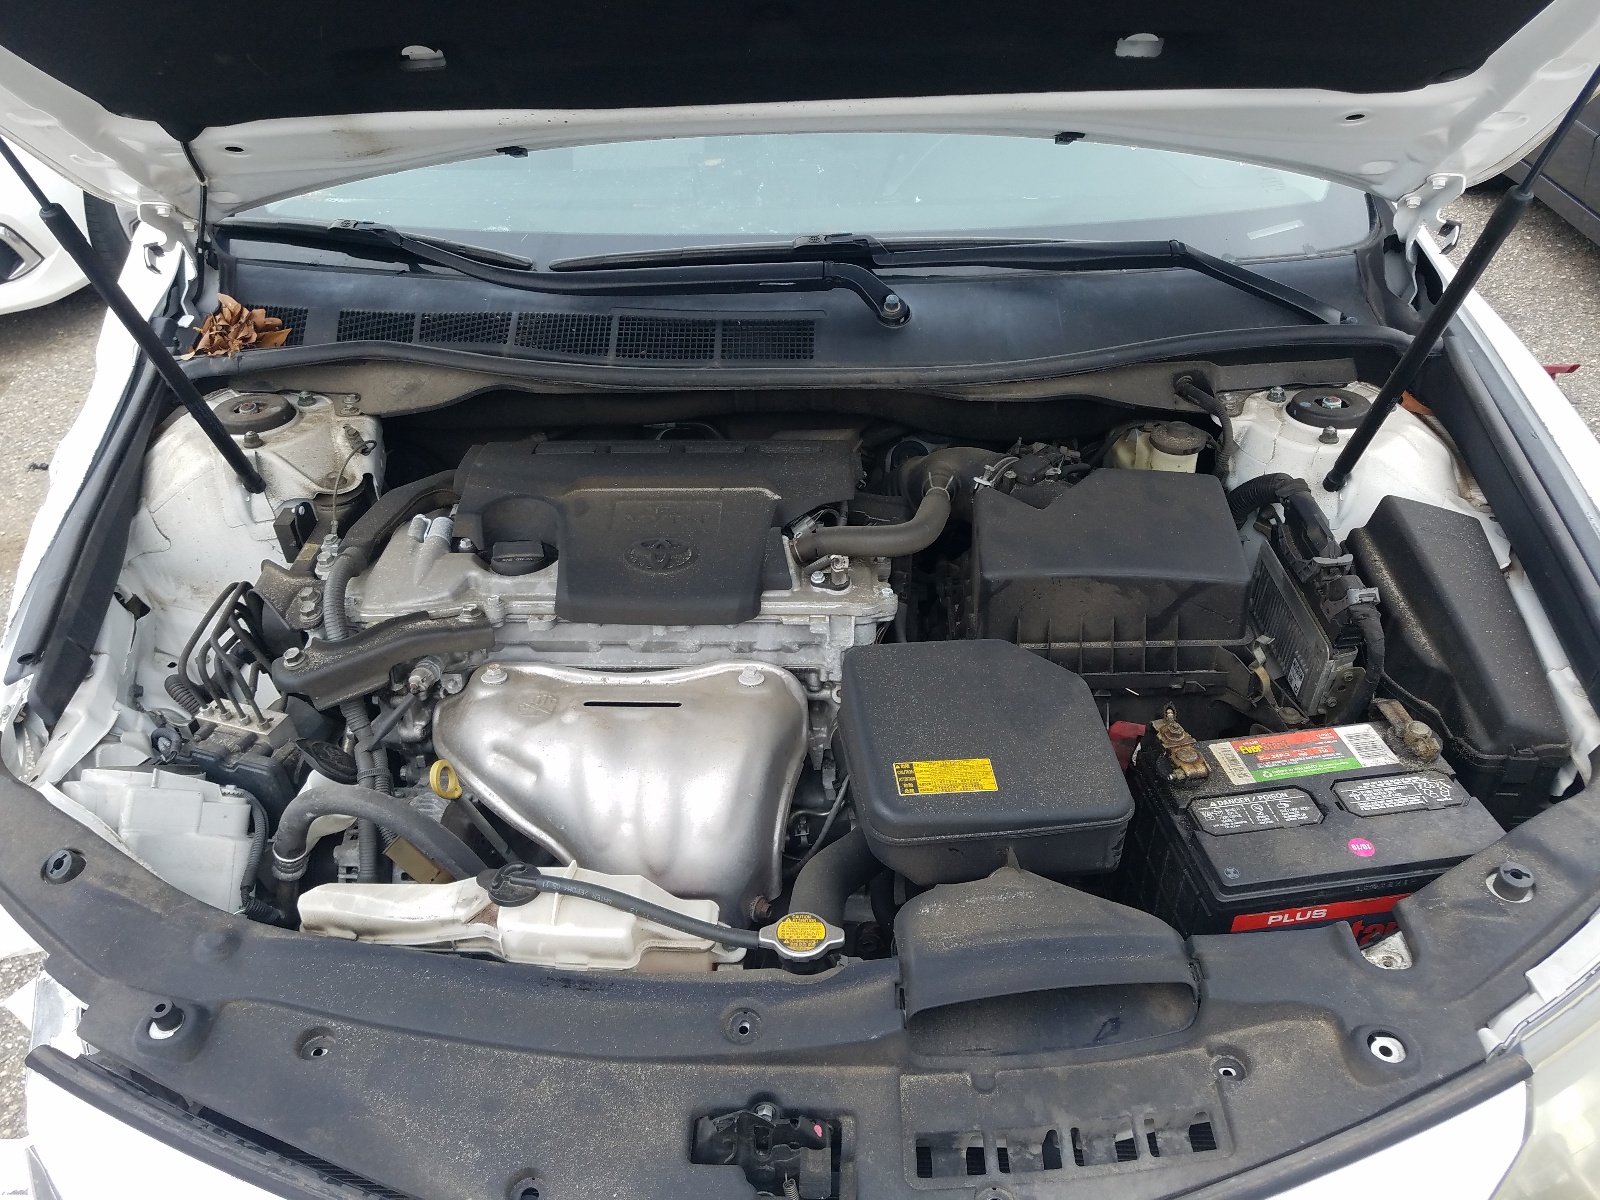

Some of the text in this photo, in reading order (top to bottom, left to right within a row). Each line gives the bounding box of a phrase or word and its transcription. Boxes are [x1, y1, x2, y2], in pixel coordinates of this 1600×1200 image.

[1217, 796, 1250, 806] DANGER
[1257, 792, 1288, 800] POISON
[1268, 908, 1328, 925] PLUS
